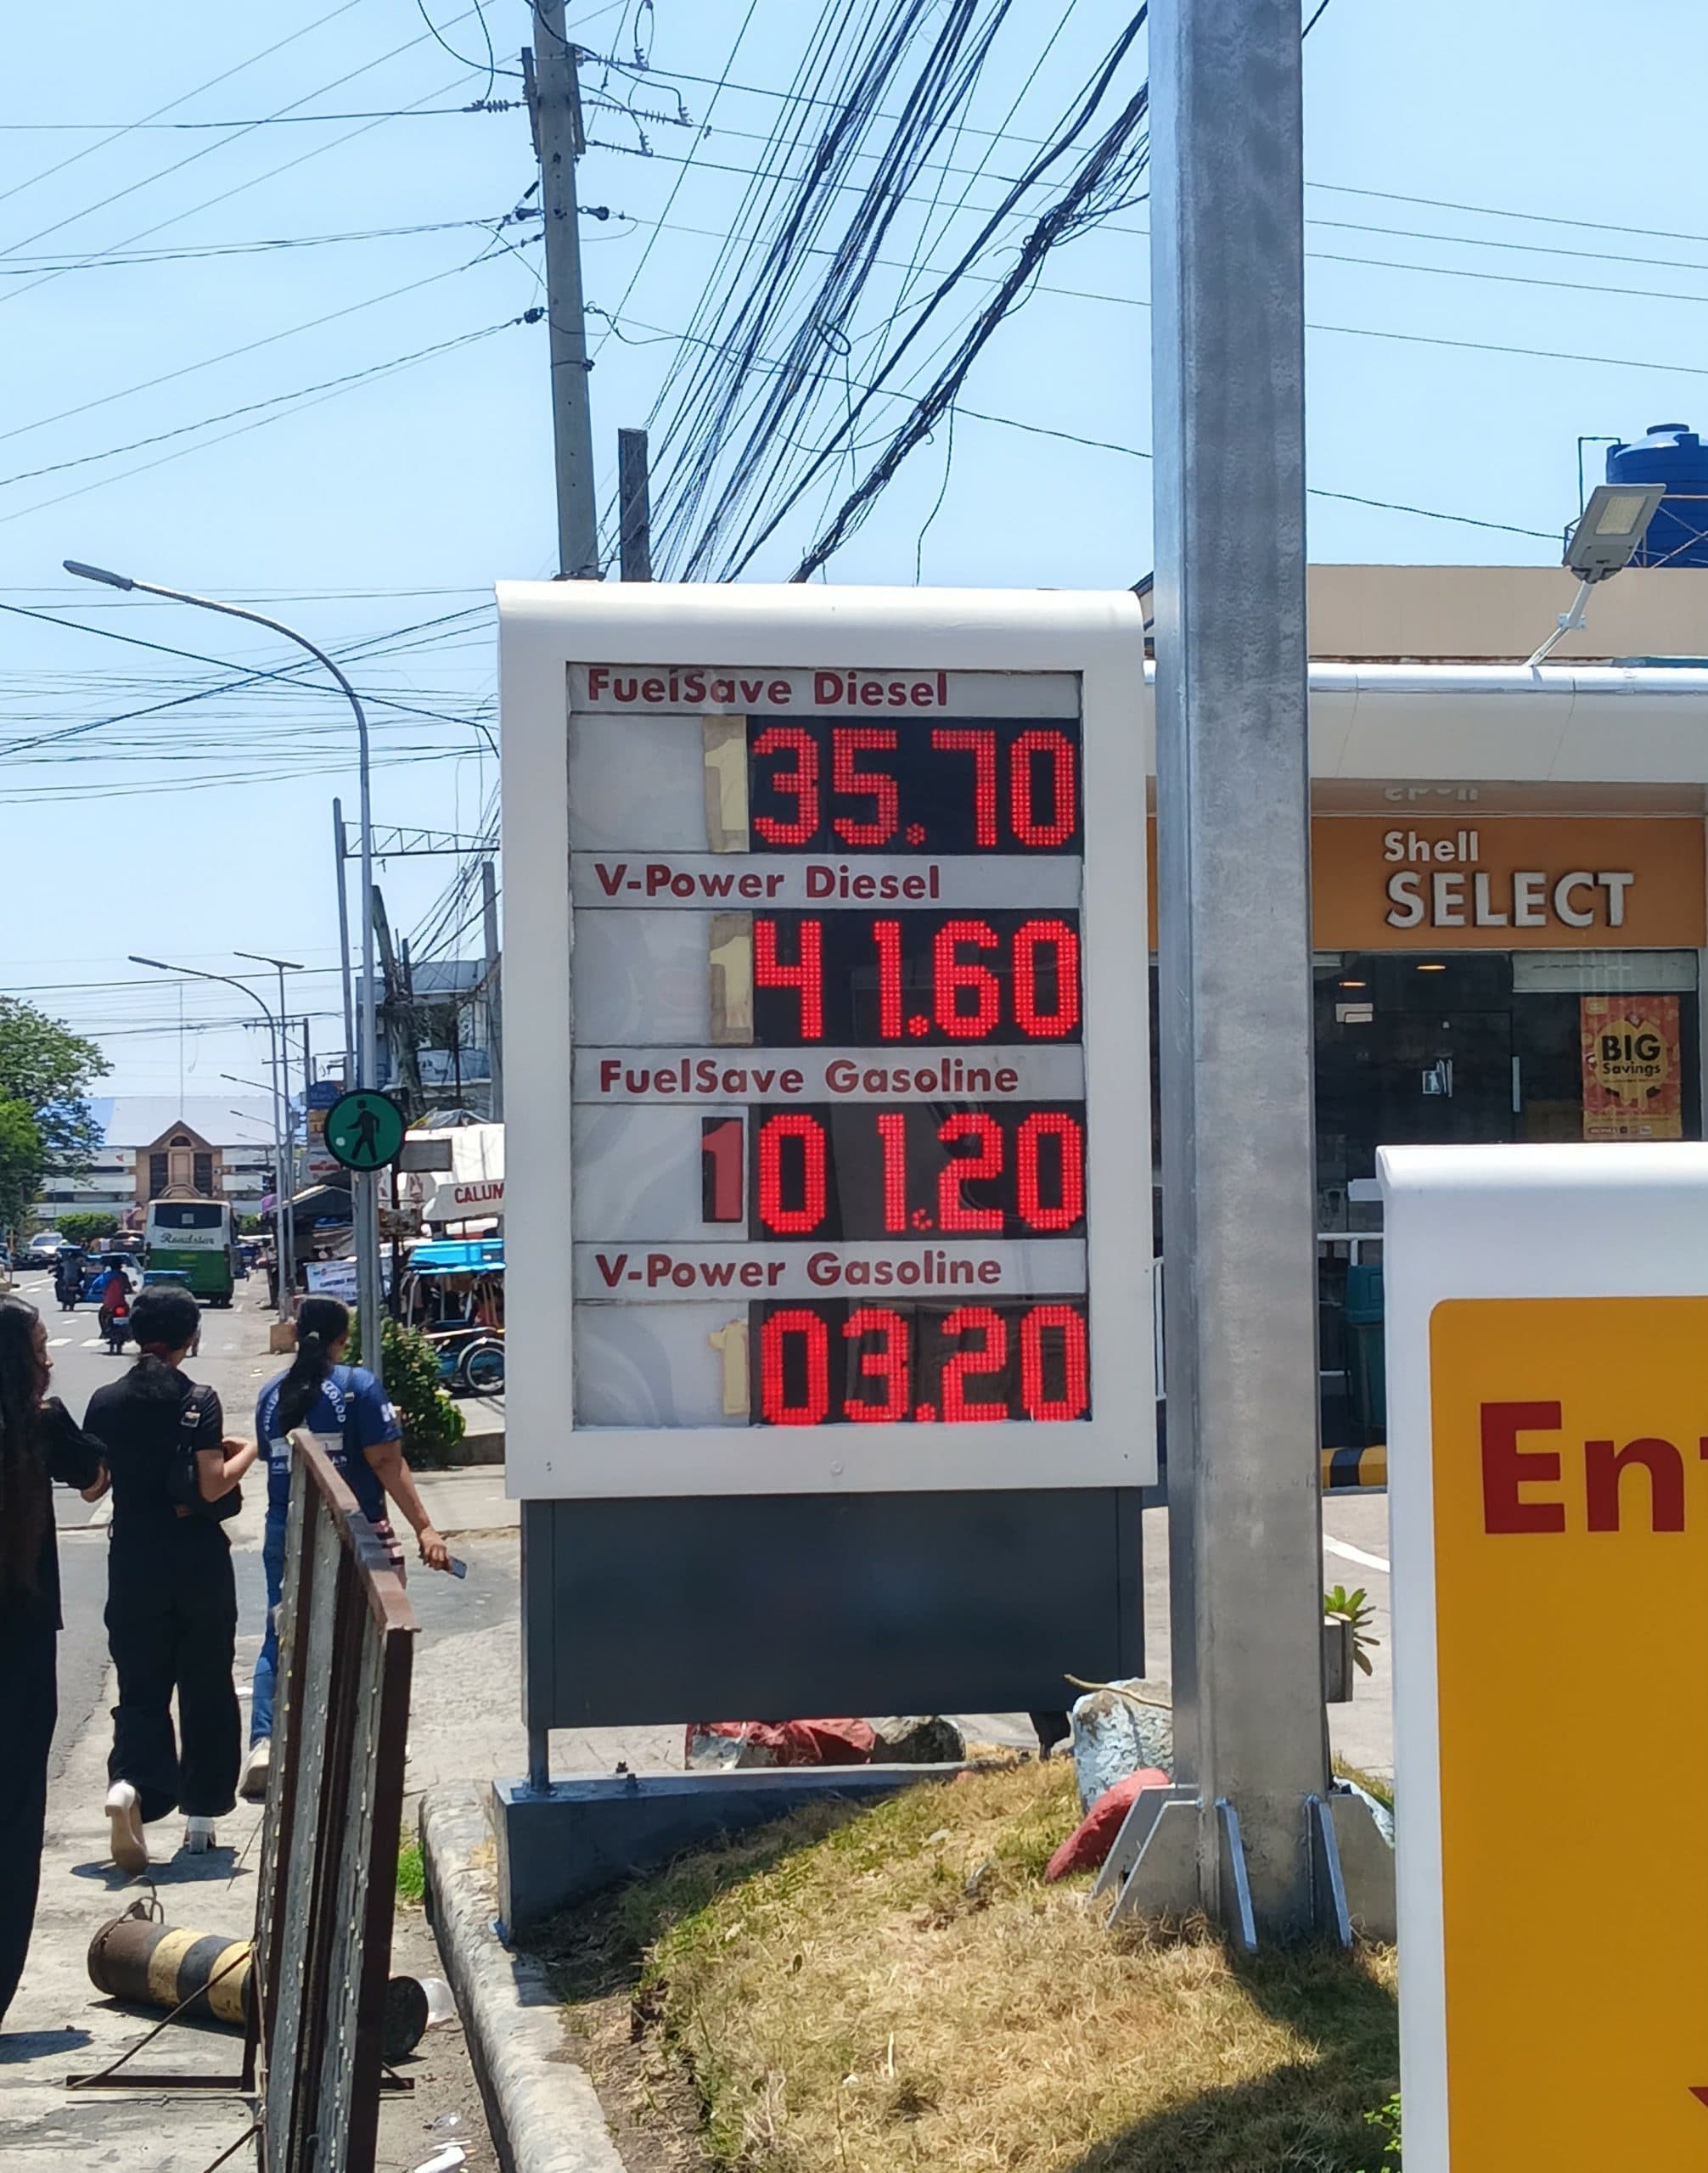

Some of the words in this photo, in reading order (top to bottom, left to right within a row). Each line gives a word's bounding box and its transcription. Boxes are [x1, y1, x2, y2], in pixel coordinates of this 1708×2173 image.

[588, 668, 792, 704] FuelSave
[814, 671, 947, 706] Diesel
[1384, 830, 1479, 862] Shell
[594, 863, 784, 898] V-Power
[806, 865, 940, 900] Diesel
[1385, 870, 1635, 929] SELECT
[1602, 1033, 1661, 1062] BIG
[599, 1058, 805, 1094] FuelSave
[824, 1058, 1020, 1094] Gasoline
[1602, 1061, 1661, 1078] Savings
[595, 1254, 786, 1288] V-Power
[806, 1250, 1003, 1288] Gasoline
[1480, 1400, 1708, 1535] En
